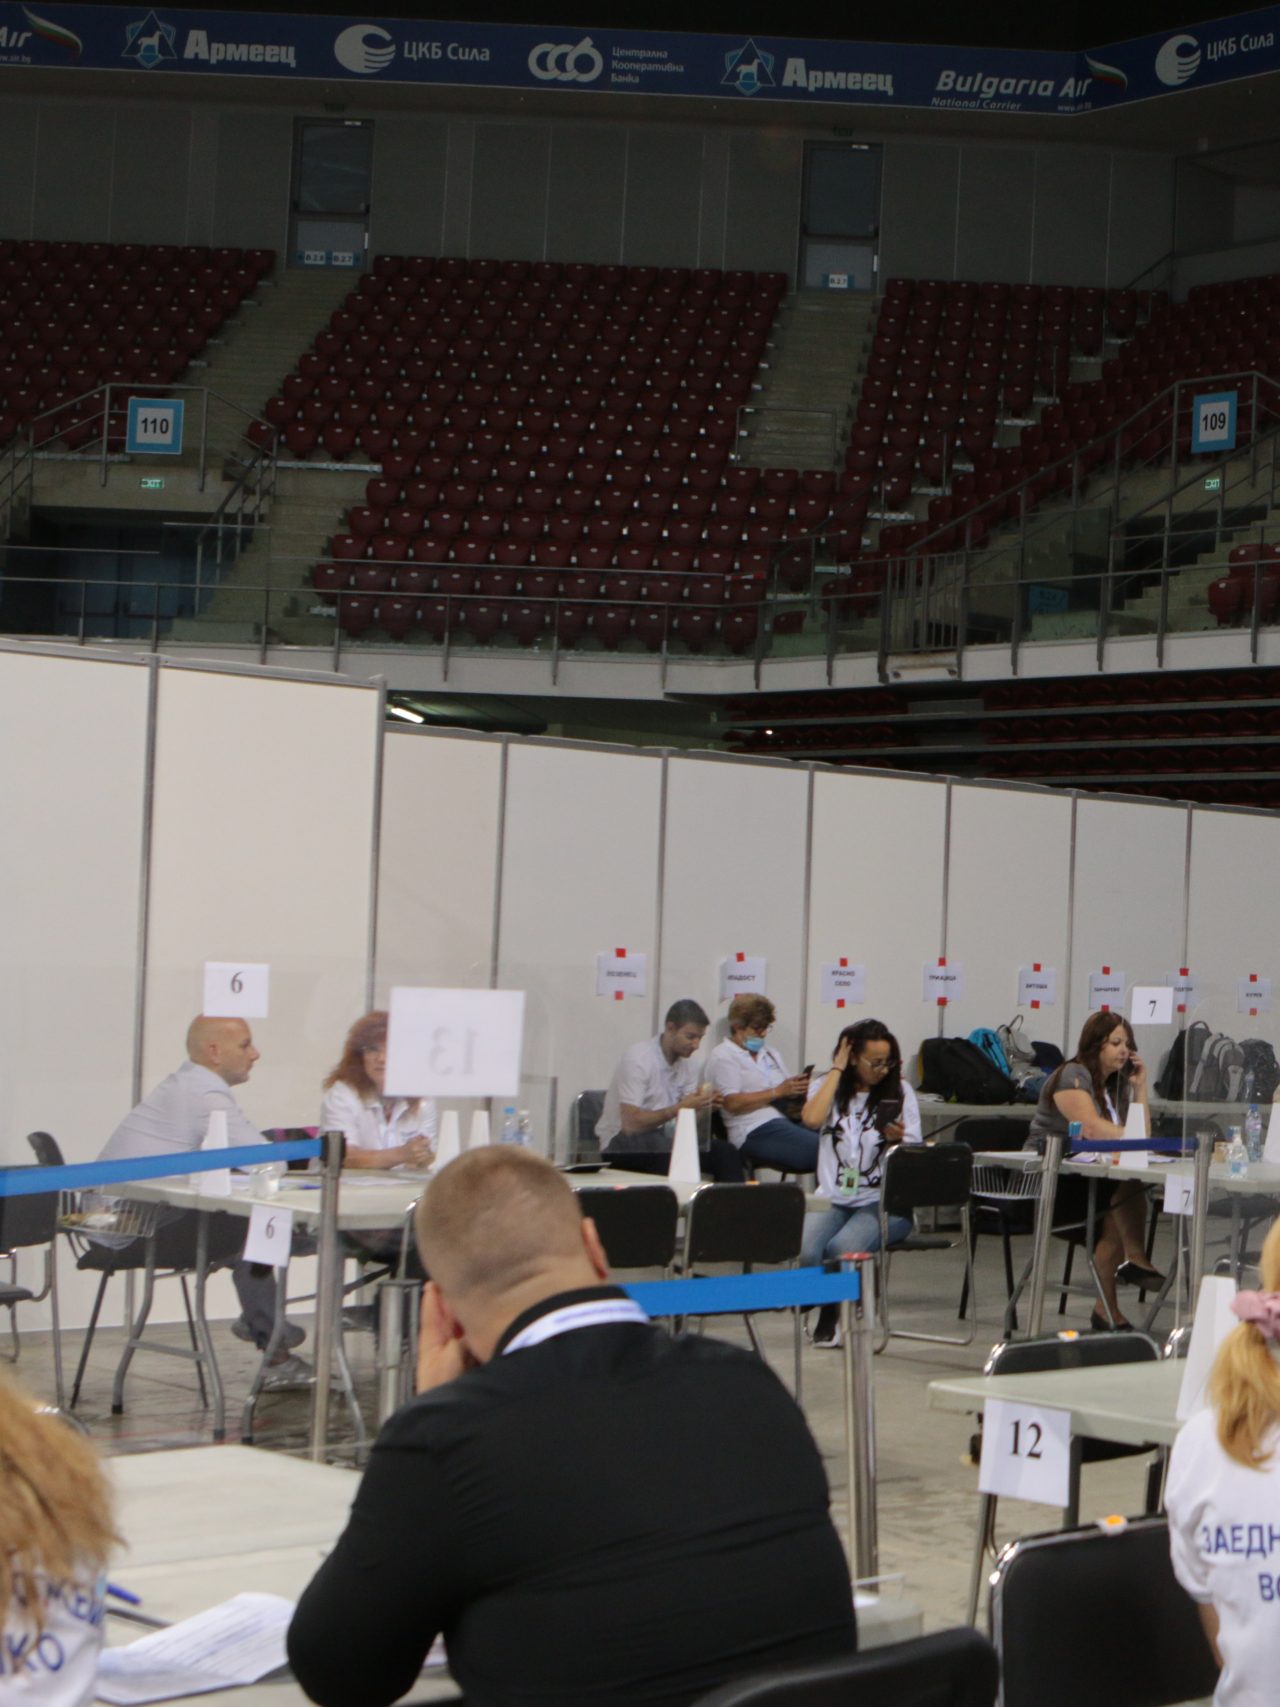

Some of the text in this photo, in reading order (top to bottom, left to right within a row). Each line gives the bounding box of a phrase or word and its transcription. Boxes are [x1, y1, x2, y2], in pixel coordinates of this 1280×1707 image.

[184, 29, 297, 68] Армеец
[403, 41, 490, 62] ЦКБ Сила
[612, 46, 668, 59] Централна
[1207, 32, 1275, 62] ЦКБ Сила
[611, 60, 684, 74] Кооперативна
[782, 57, 894, 96] Армеец
[611, 73, 640, 84] Банка
[935, 69, 1092, 98] Bulgaria Air
[931, 96, 1021, 111] National Carrier
[141, 417, 169, 434] 110
[1202, 412, 1226, 431] 109
[229, 970, 244, 994] 6
[1148, 1000, 1157, 1017] 7
[1182, 1189, 1190, 1207] 7
[265, 1214, 275, 1240] 6
[1009, 1418, 1043, 1461] 12
